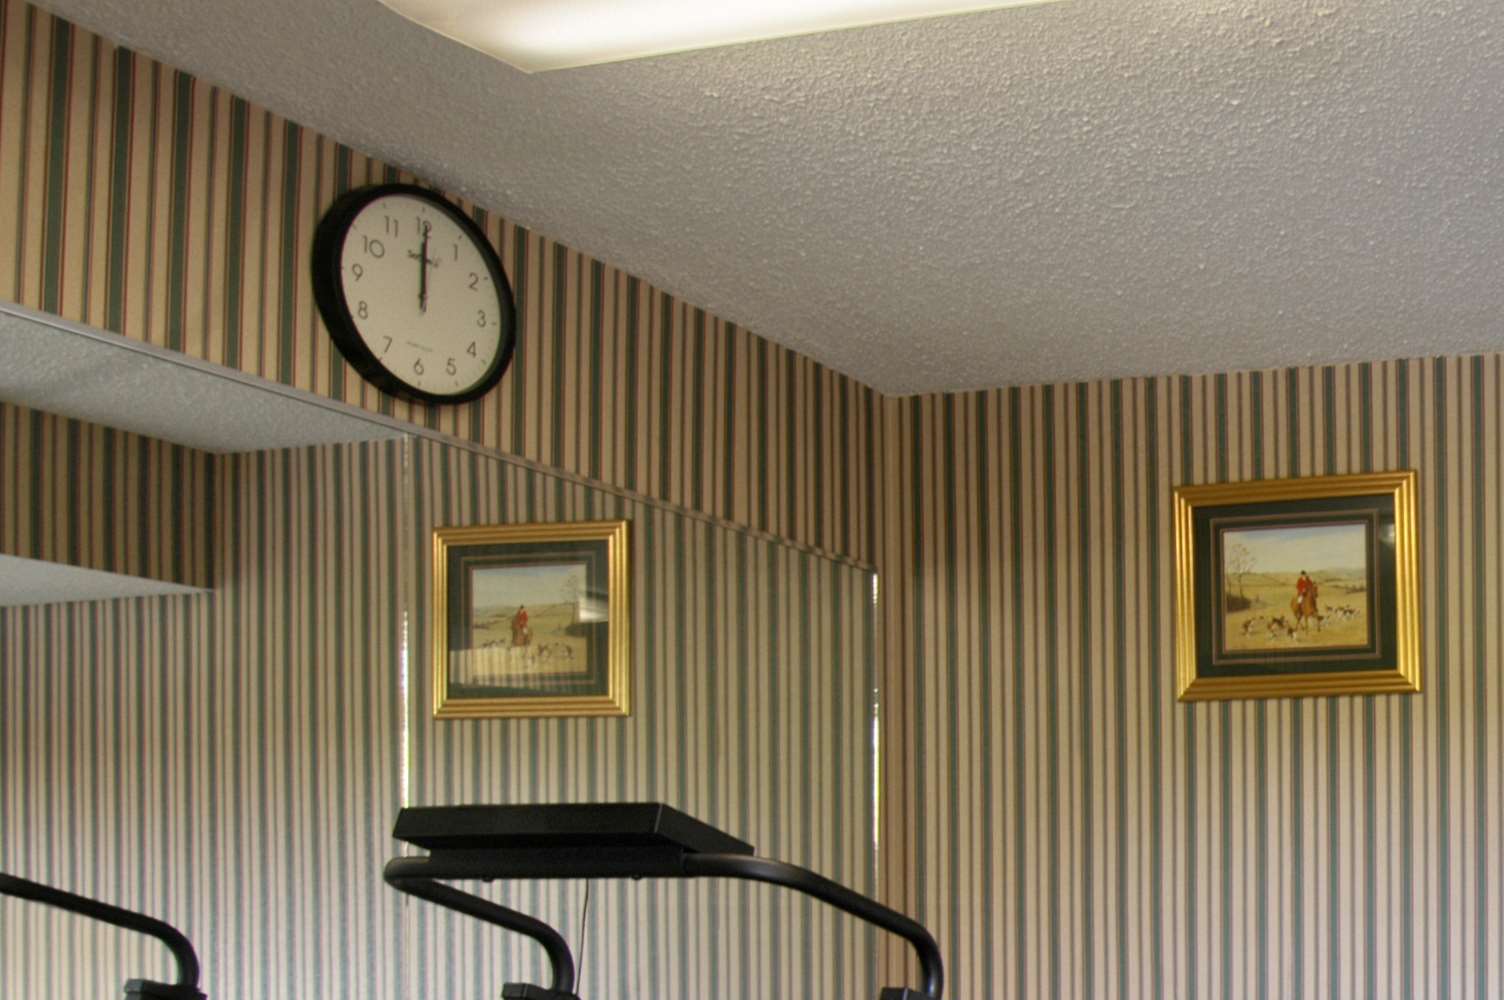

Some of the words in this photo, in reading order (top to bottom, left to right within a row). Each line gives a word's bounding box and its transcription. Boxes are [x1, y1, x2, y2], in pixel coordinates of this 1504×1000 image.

[383, 215, 399, 238] 11
[362, 235, 385, 258] 10
[453, 243, 459, 261] 1
[351, 263, 364, 281] 9
[468, 272, 480, 291] 2
[357, 300, 369, 320] 8
[476, 309, 487, 328] 3
[382, 335, 393, 353] 7
[466, 341, 477, 358] 4
[413, 357, 424, 376] 6
[445, 357, 457, 376] 5
